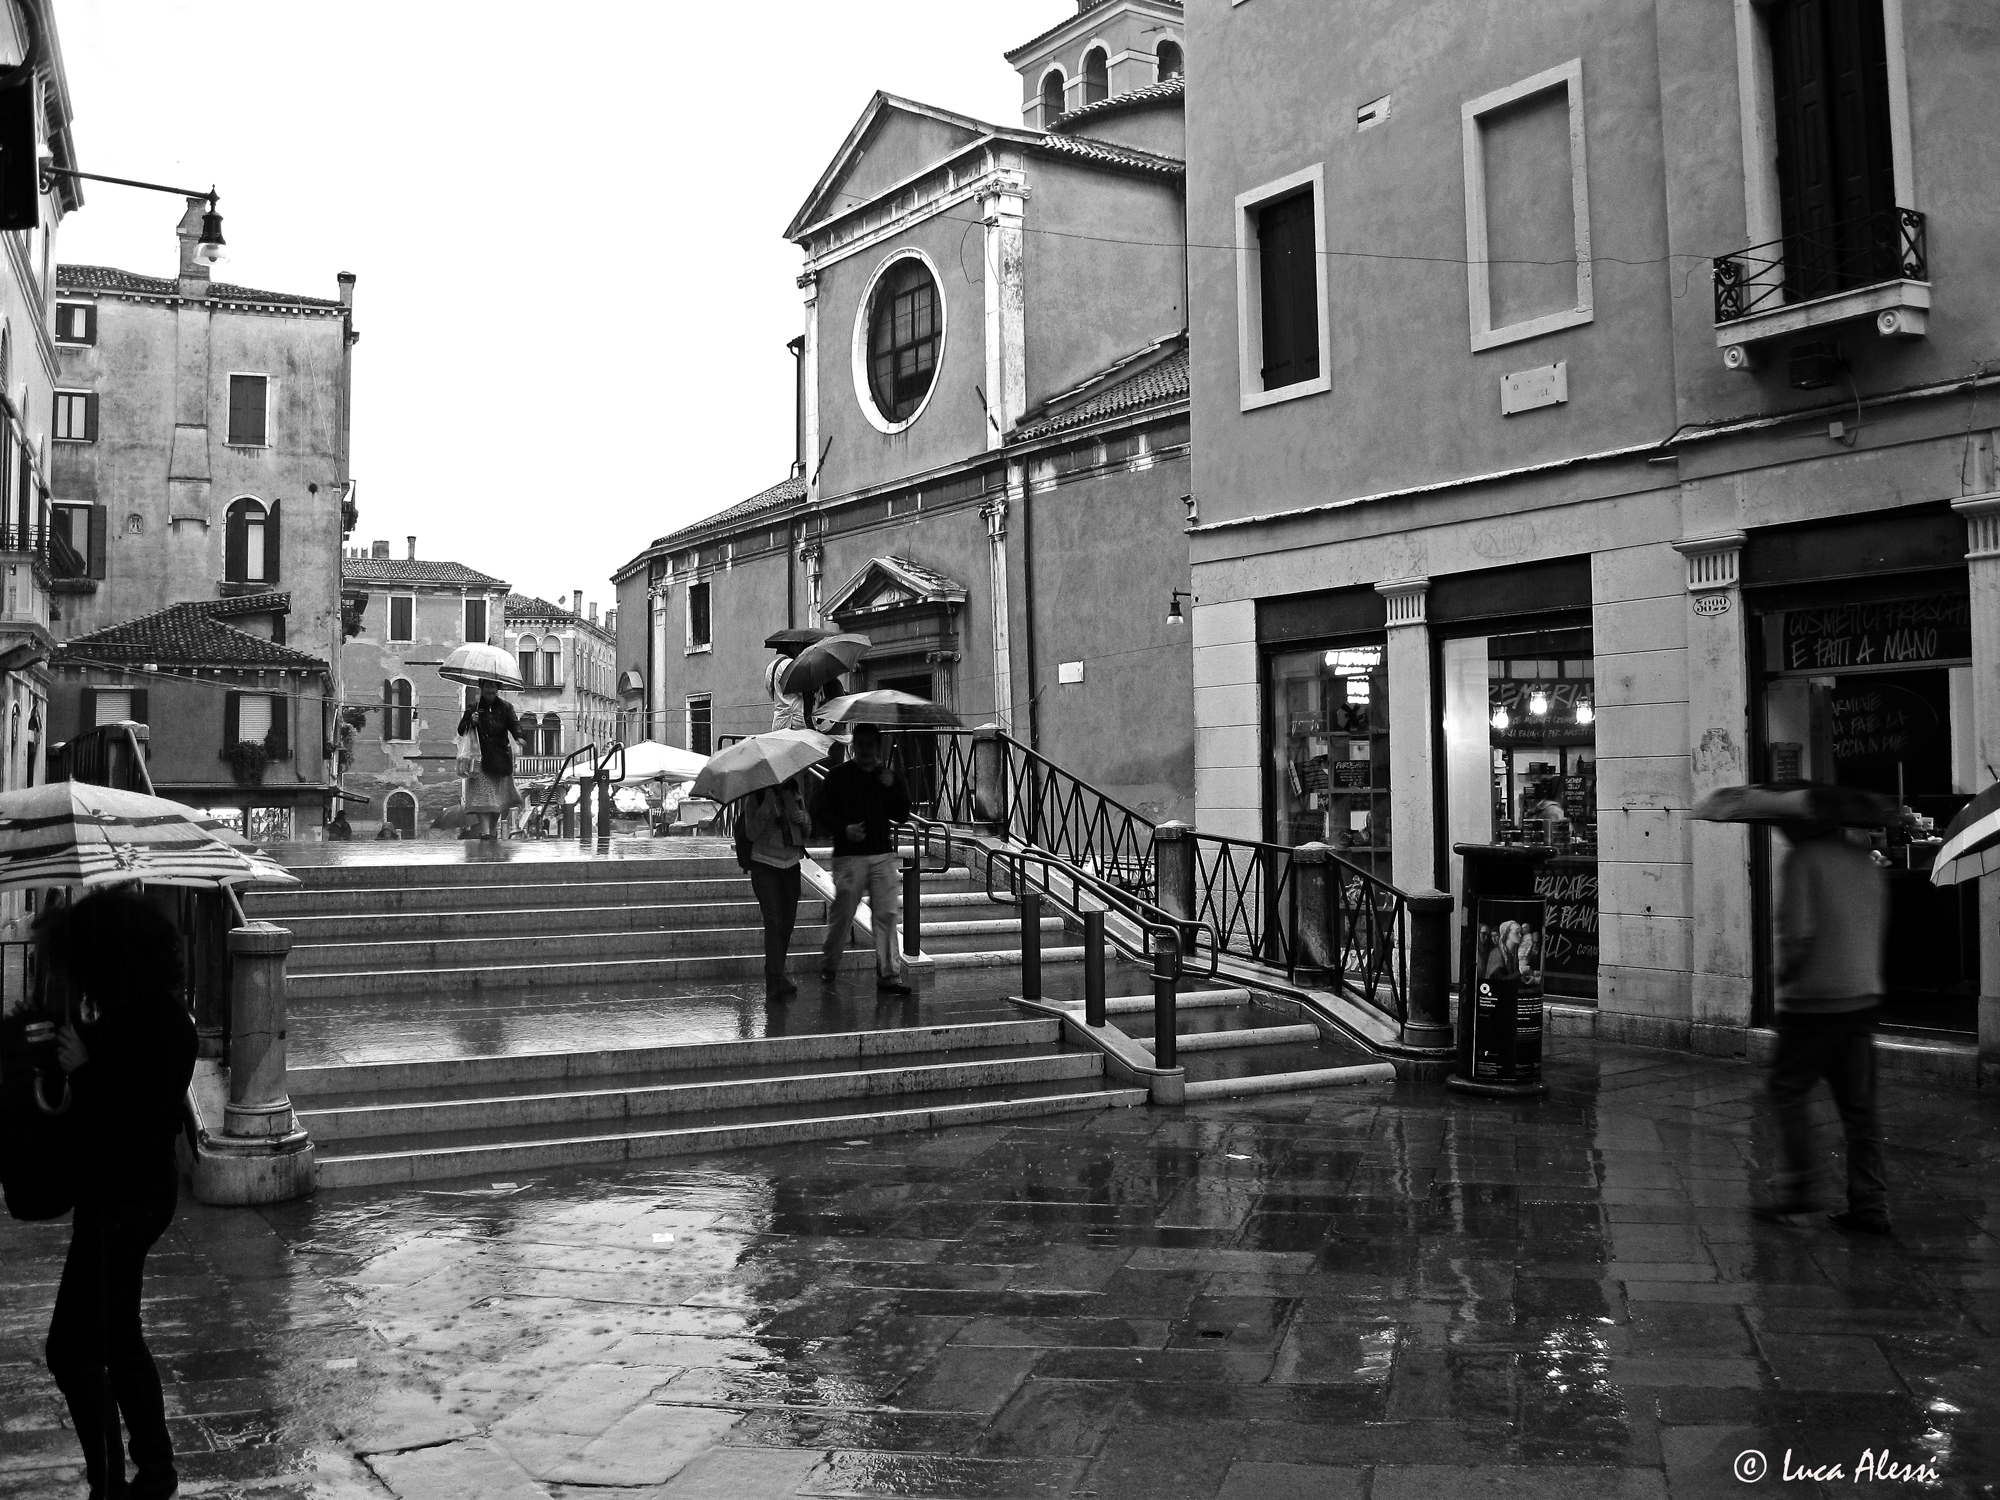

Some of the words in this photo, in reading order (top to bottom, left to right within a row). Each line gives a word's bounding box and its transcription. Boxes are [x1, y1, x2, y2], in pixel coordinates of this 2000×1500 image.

[1789, 605, 1880, 637] COSMETICI
[1791, 636, 1808, 668] E
[1813, 635, 1852, 667] FATTI
[1856, 635, 1875, 664] A
[1883, 626, 1938, 662] MANO
[1851, 714, 1882, 735] FATE
